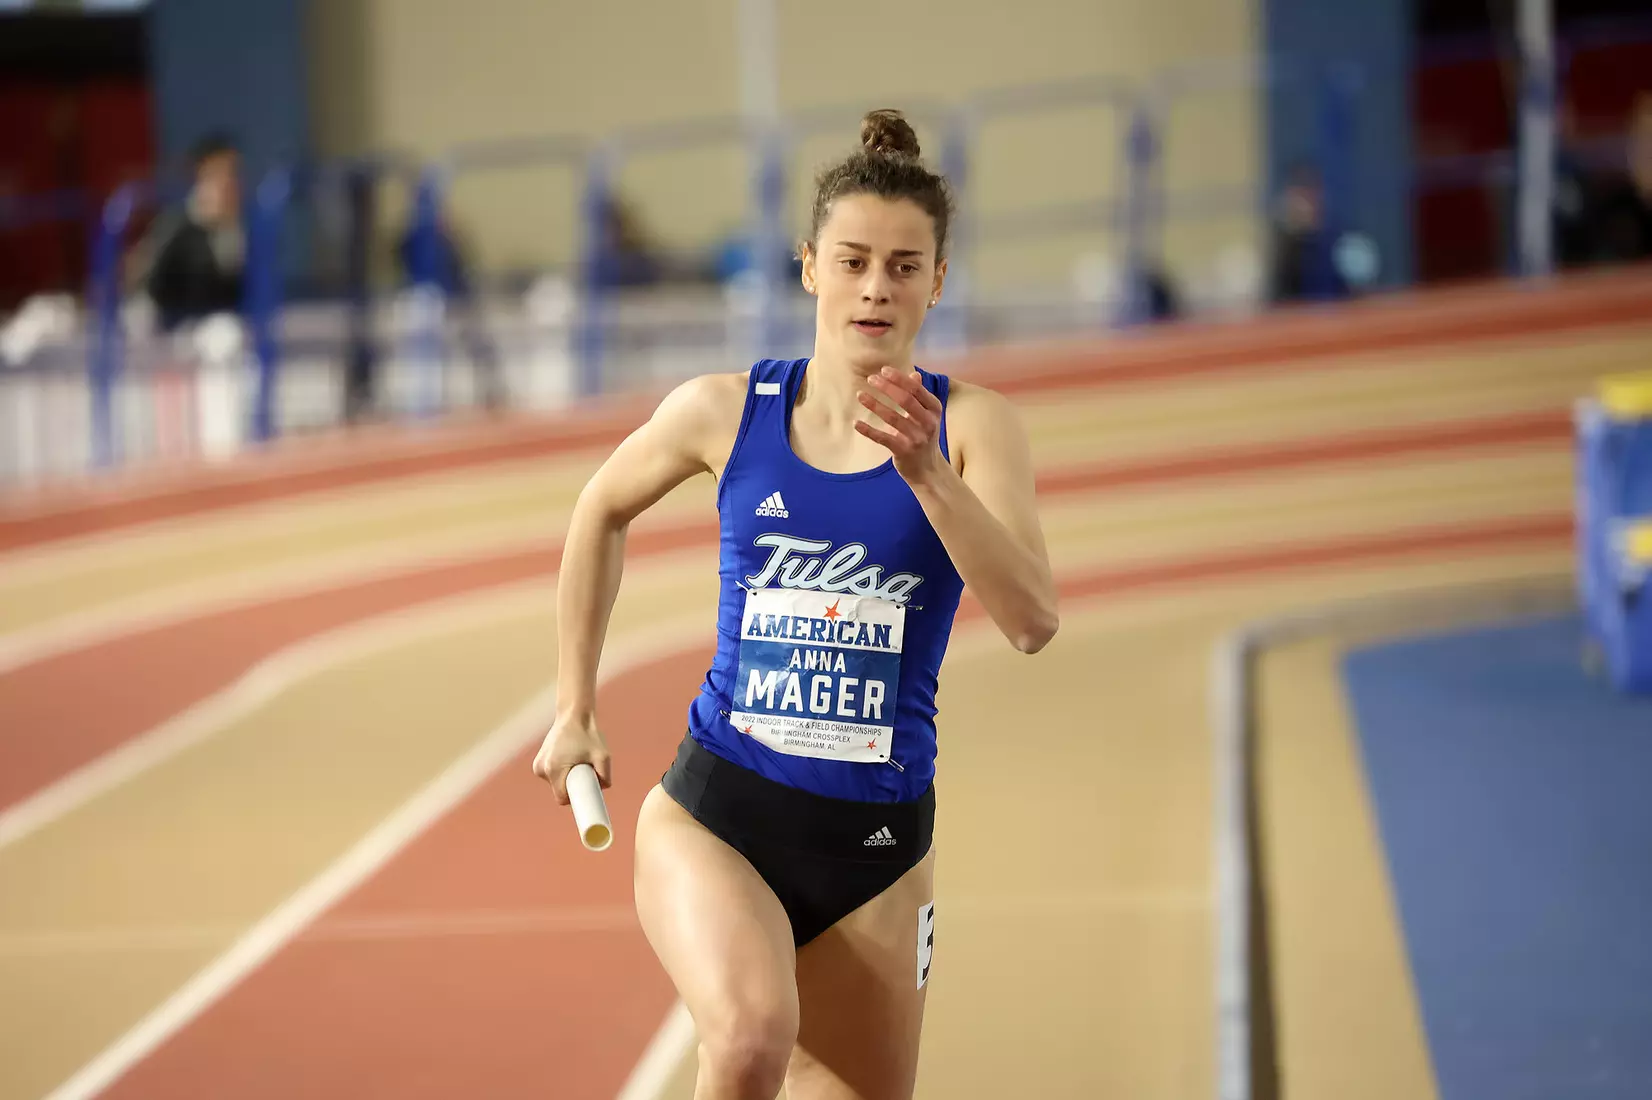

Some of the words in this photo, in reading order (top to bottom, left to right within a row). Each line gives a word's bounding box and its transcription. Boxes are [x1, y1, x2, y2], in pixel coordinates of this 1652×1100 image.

[755, 507, 789, 519] adidas
[745, 532, 924, 604] Tulsa
[747, 613, 893, 649] AMERICAN
[789, 648, 846, 673] ANNA
[745, 669, 886, 720] MAGER
[741, 715, 755, 723] 2022
[756, 717, 782, 726] INDOOR
[783, 719, 804, 728] TRACK
[805, 721, 810, 729] &
[811, 721, 830, 731] FIELD
[831, 724, 882, 736] CHAMPIONSHIPS
[813, 732, 851, 743] CROSSPLEX
[863, 838, 897, 846] adidas
